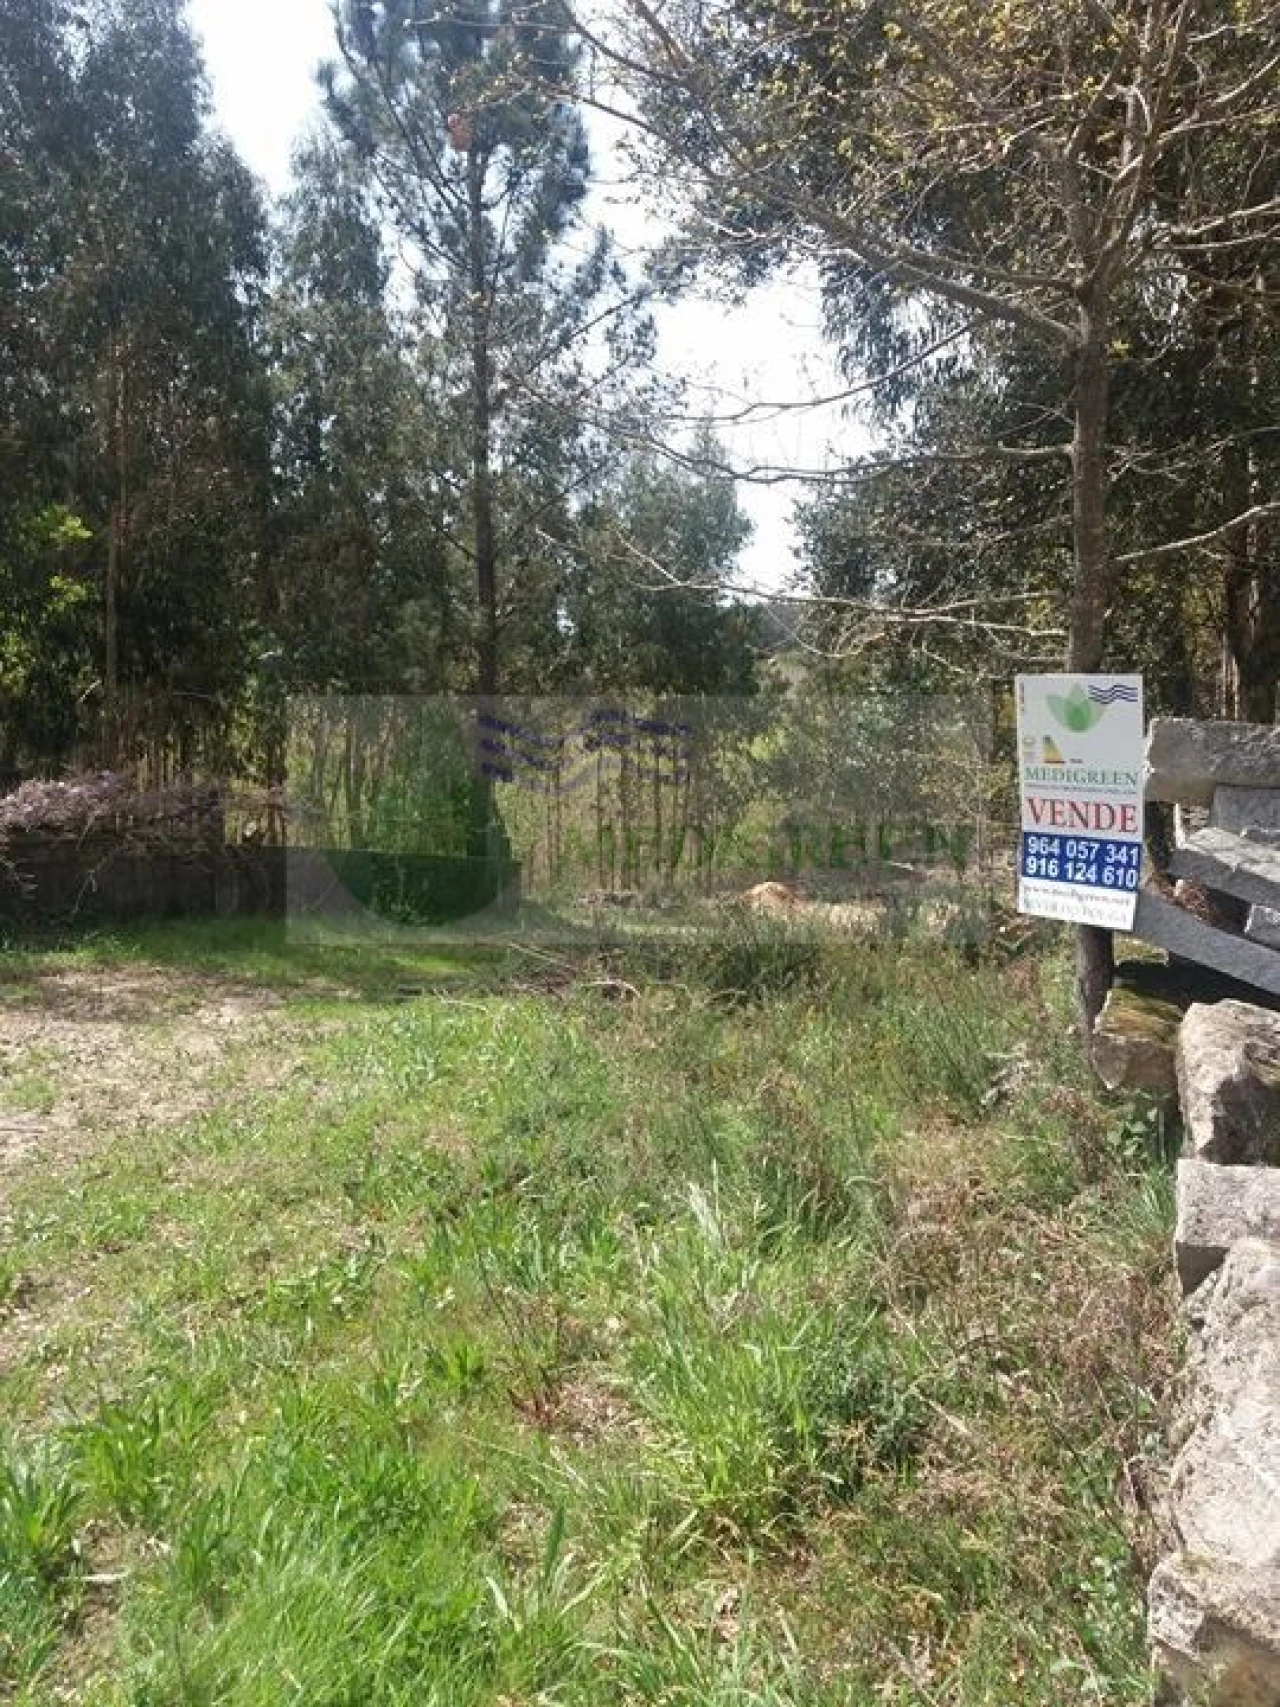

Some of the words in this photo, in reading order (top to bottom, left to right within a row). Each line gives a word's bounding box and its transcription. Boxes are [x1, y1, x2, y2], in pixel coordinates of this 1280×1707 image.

[1024, 766, 1138, 787] MEDIGREEN
[1026, 797, 1139, 834] VENDE
[1027, 836, 1061, 857] 964
[1066, 838, 1101, 862] 057
[1106, 843, 1139, 866] 341
[1025, 855, 1059, 878] 916
[1064, 861, 1099, 883] 124
[1102, 866, 1138, 889] 610
